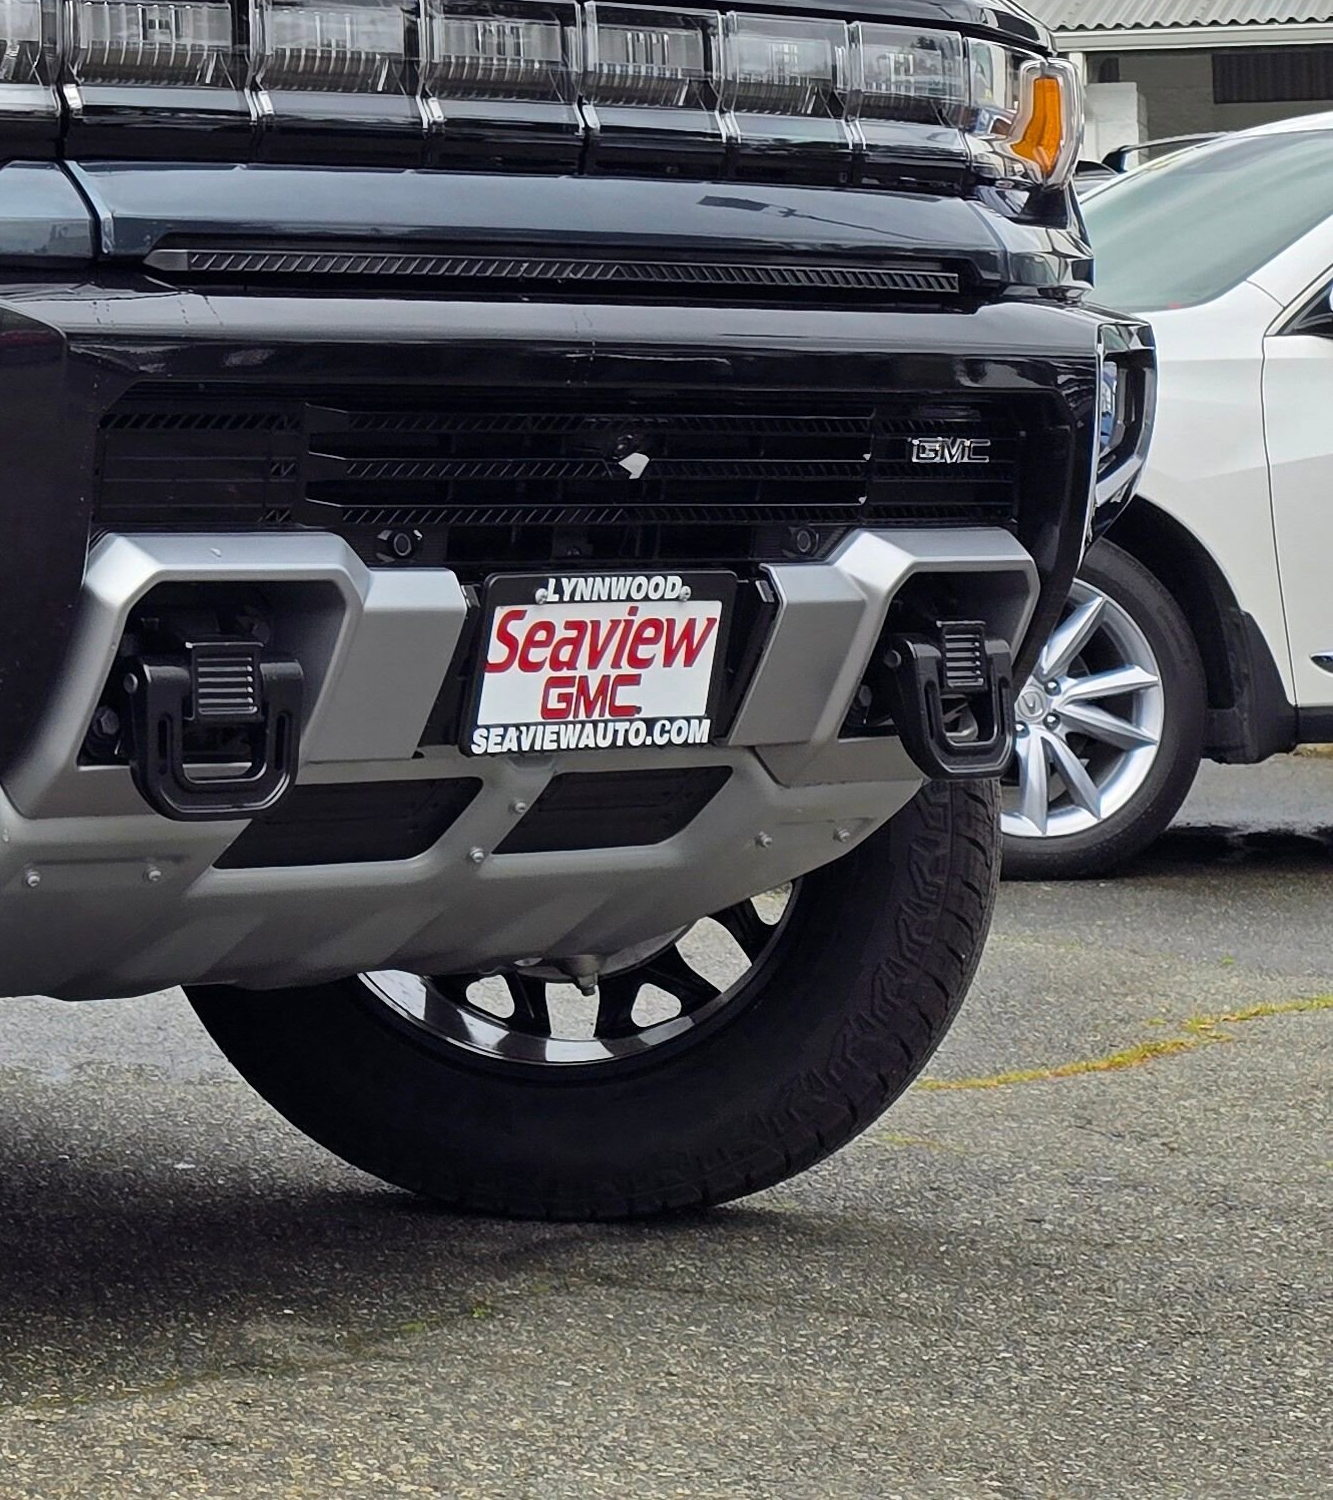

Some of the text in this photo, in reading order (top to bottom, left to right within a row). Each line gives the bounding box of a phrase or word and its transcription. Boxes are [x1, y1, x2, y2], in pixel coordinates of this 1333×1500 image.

[911, 436, 991, 463] GMC
[546, 576, 683, 602] LYNNWOOD
[485, 606, 717, 673] Seaview
[541, 674, 642, 720] GMC
[471, 719, 711, 755] SEAVIEWAUTO.COM
